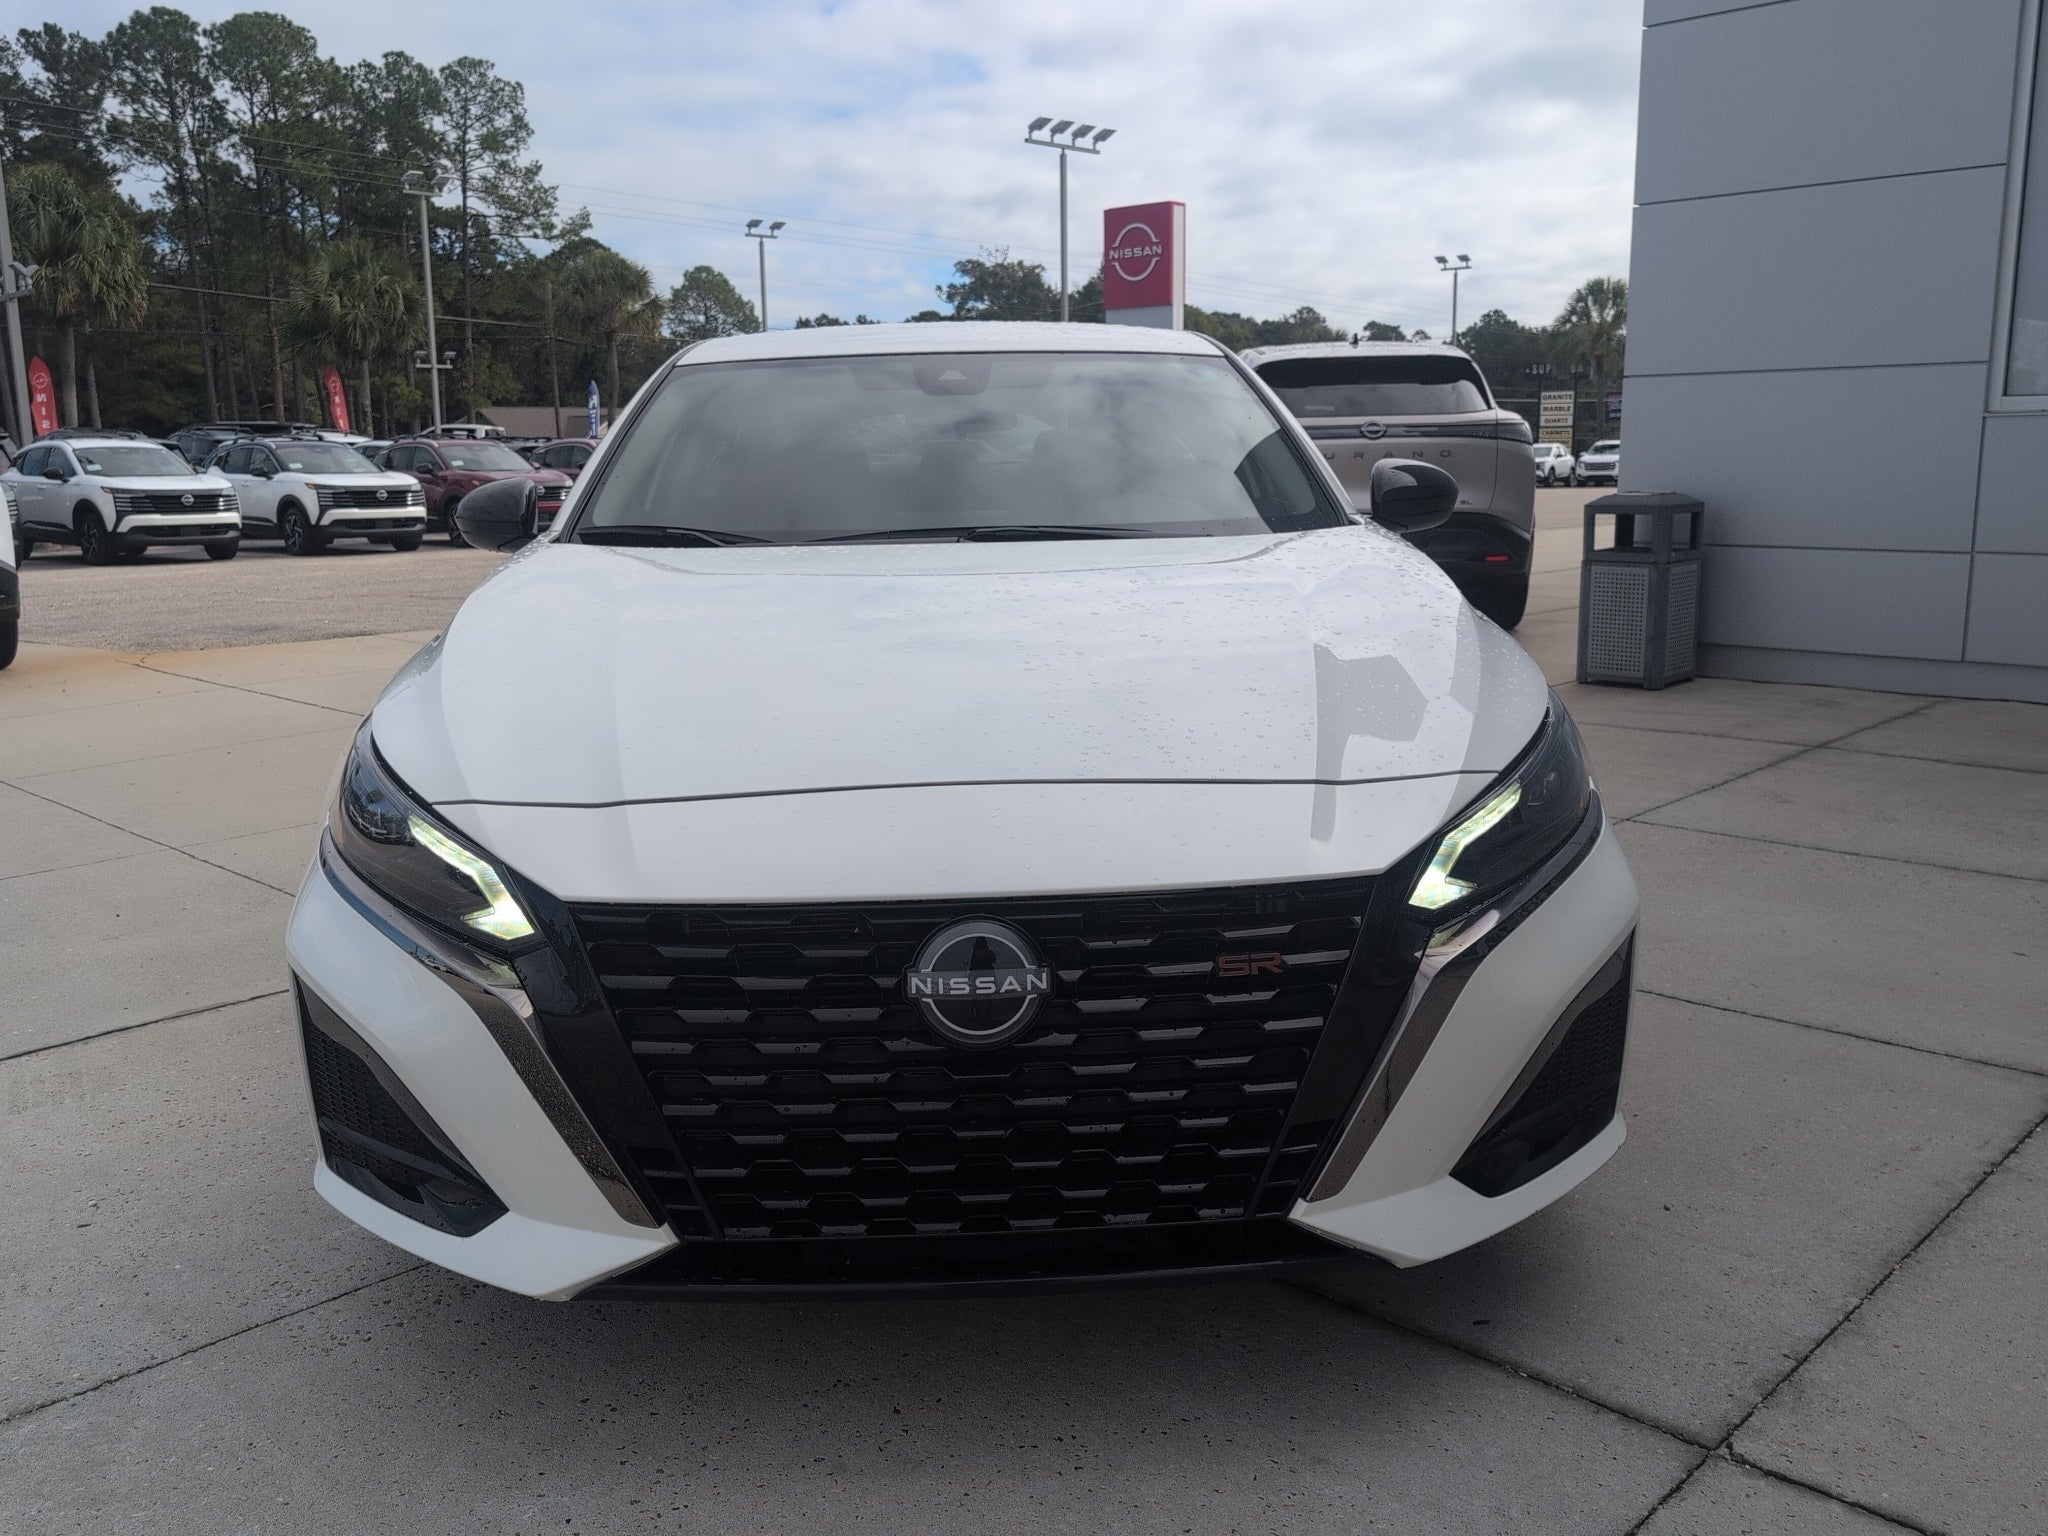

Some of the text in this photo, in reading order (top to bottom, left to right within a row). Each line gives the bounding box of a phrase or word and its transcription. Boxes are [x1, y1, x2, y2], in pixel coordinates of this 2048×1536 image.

[1109, 244, 1162, 259] NISSAN
[1217, 952, 1283, 977] SR
[910, 971, 1048, 996] NISSAN
